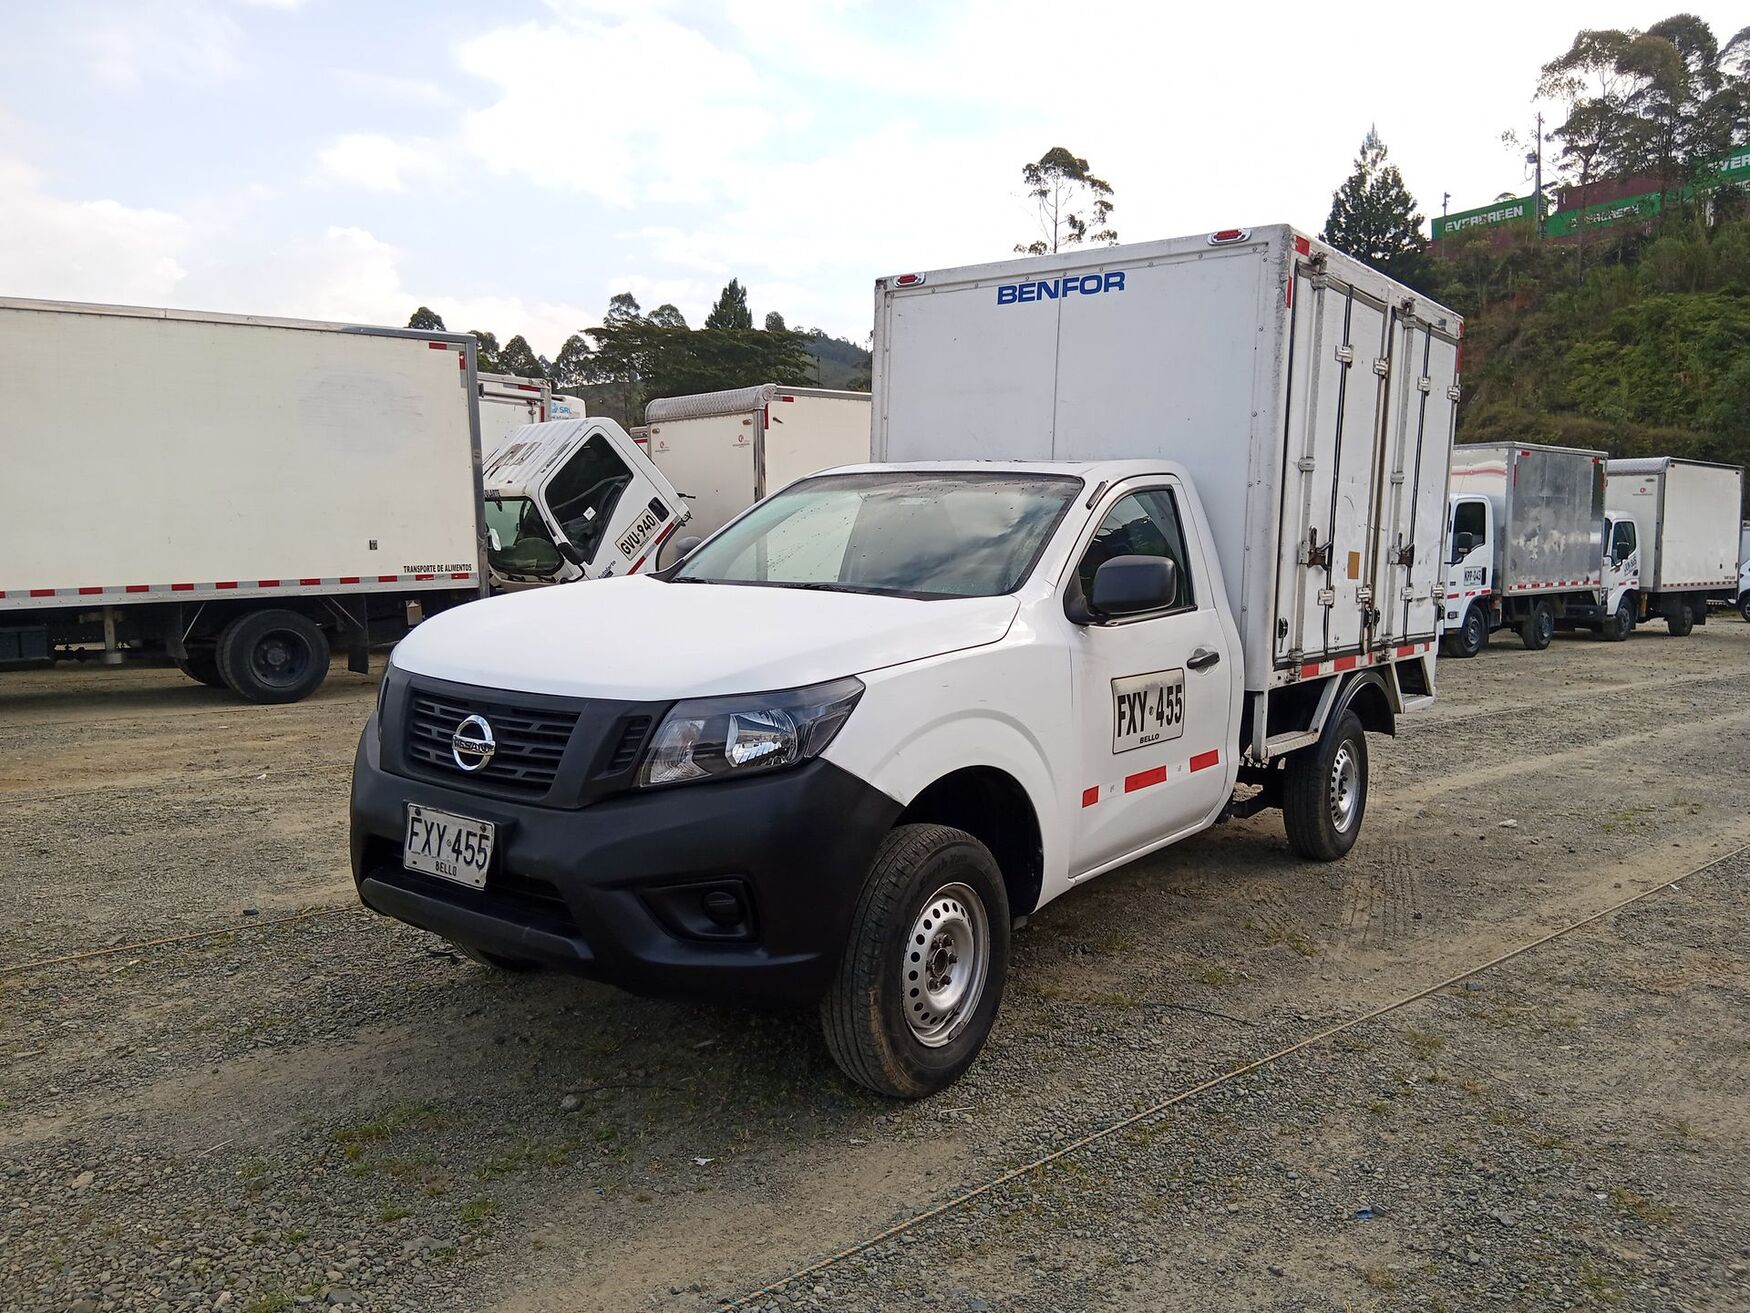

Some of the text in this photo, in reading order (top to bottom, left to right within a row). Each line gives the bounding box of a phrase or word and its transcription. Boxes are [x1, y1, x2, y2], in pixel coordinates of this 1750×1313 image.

[997, 271, 1126, 305] BENFOR
[403, 563, 473, 573] TRANSPORTE DE ALIMENTOS
[453, 736, 495, 755] NISSAN
[1140, 733, 1160, 744] BELLO
[435, 860, 457, 876] BELLO
